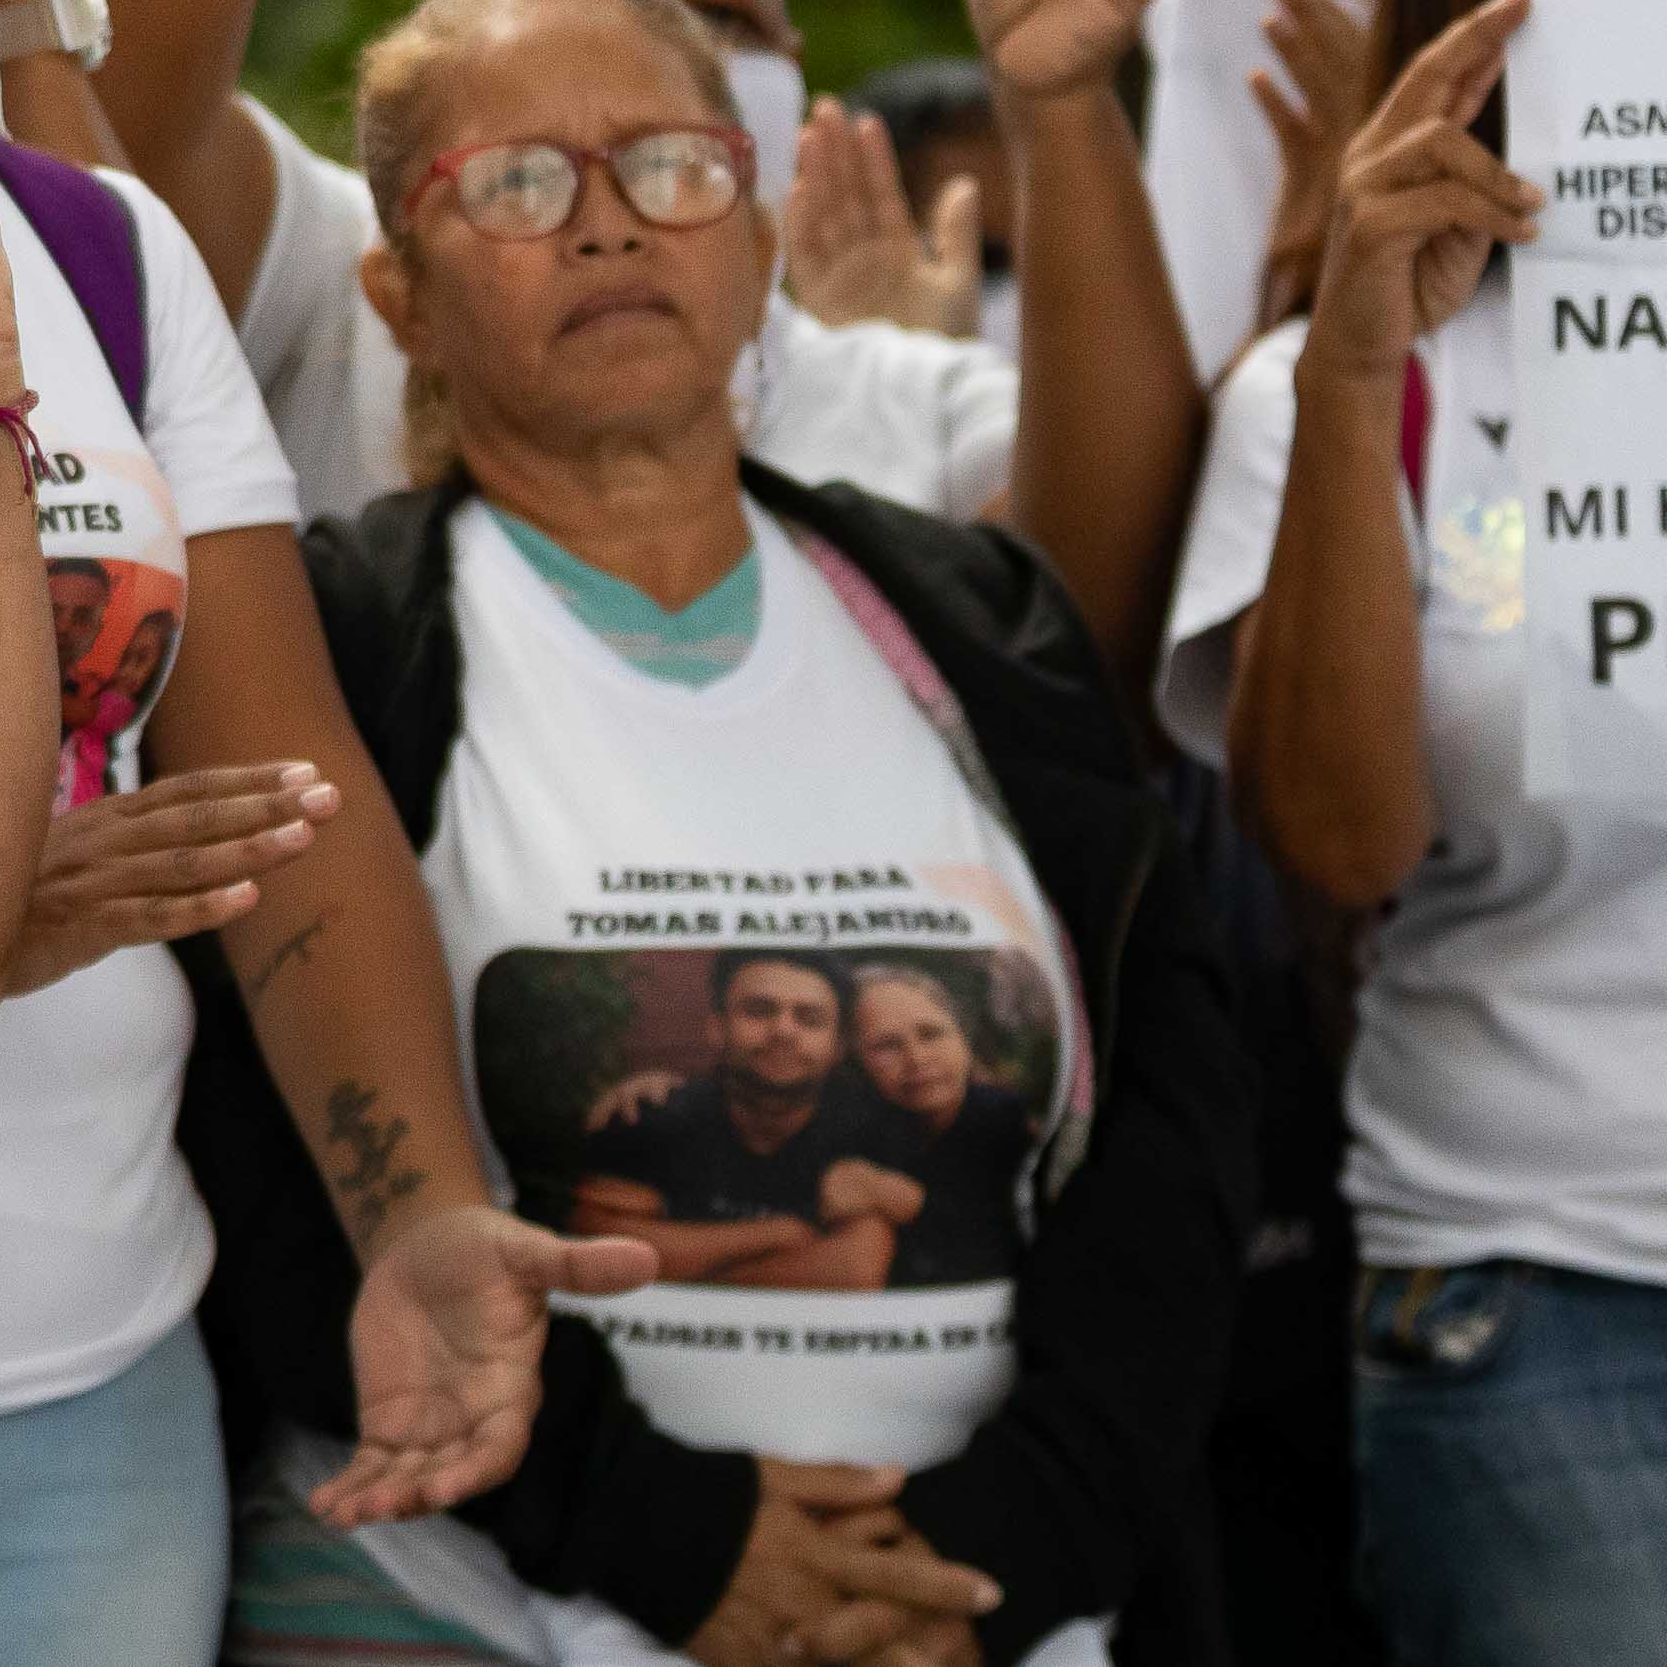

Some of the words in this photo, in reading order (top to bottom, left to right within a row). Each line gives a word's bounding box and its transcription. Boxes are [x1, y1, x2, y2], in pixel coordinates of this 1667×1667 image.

[1545, 484, 1628, 540] MI
[599, 864, 796, 894] LIBERTAD
[802, 863, 913, 892] PARA
[566, 909, 722, 937] TOMAS
